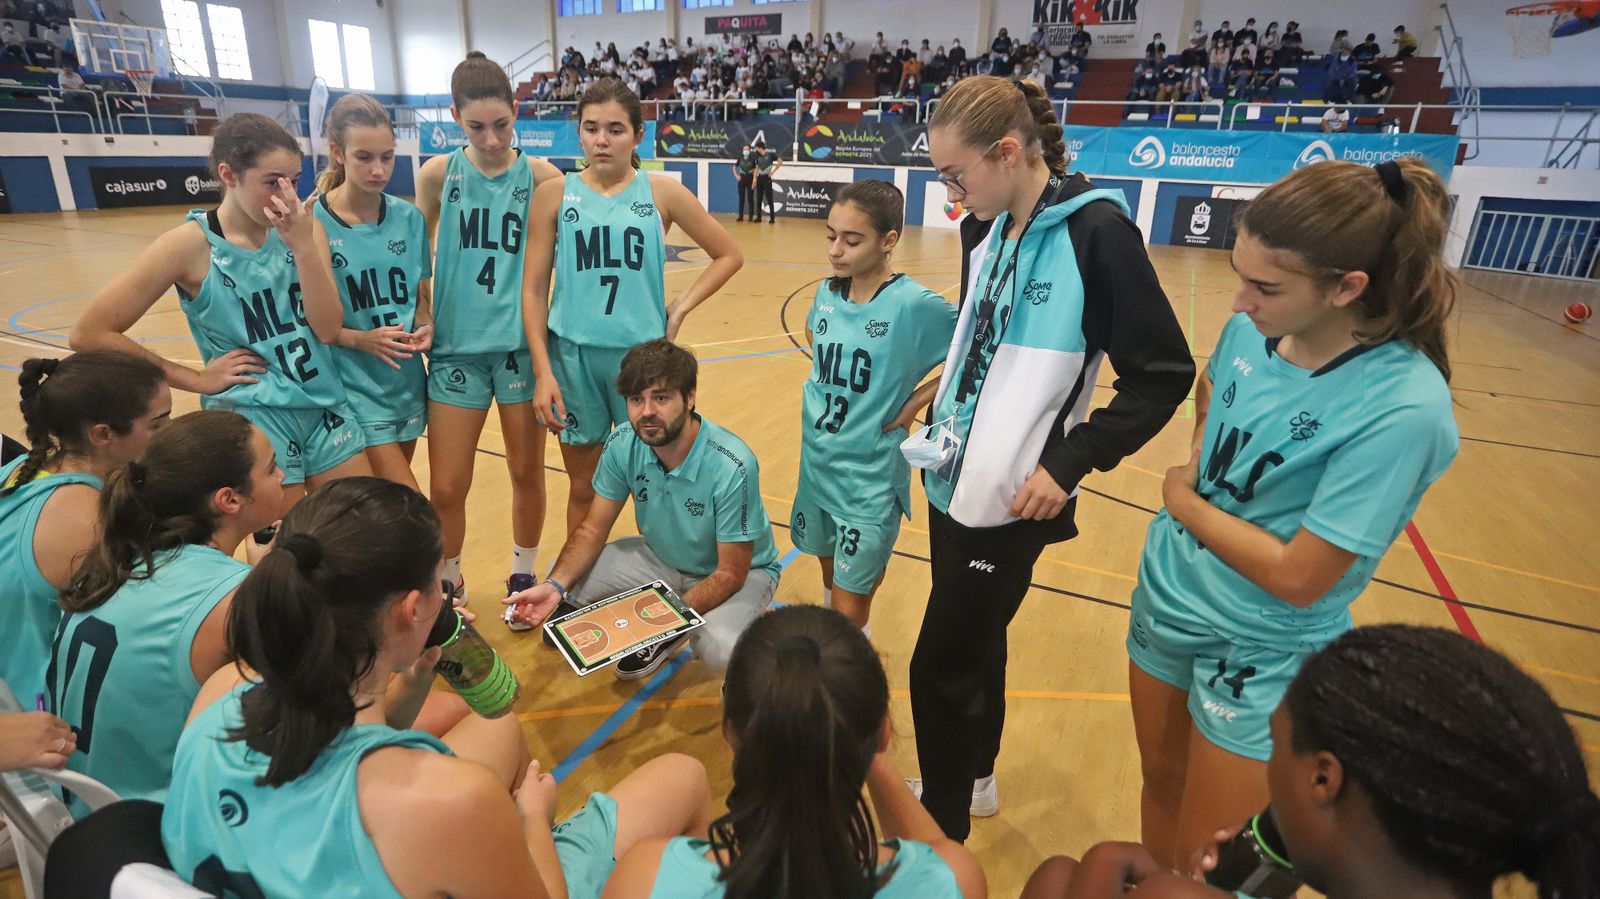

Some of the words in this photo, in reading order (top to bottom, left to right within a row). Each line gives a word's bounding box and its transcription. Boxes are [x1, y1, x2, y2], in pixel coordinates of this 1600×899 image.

[717, 16, 767, 29] PAQUITA
[688, 128, 730, 142] Andalucía
[837, 129, 886, 144] Andalucía
[1171, 142, 1241, 156] baloncesto
[106, 179, 155, 195] cajasur
[787, 186, 831, 201] Andalucía
[459, 208, 522, 255] MLG
[575, 226, 644, 272] MLG
[345, 267, 409, 313] MLG
[476, 257, 496, 294] 4
[600, 275, 619, 315] 7
[240, 283, 308, 345] MLG
[274, 337, 319, 383] 12
[506, 352, 519, 375] 4
[816, 343, 871, 394] MLG
[1232, 357, 1253, 377] vive
[815, 392, 848, 434] 13
[839, 525, 860, 556] 13
[968, 560, 996, 573] vive
[1208, 657, 1256, 700] 14
[1203, 700, 1236, 722] vive
